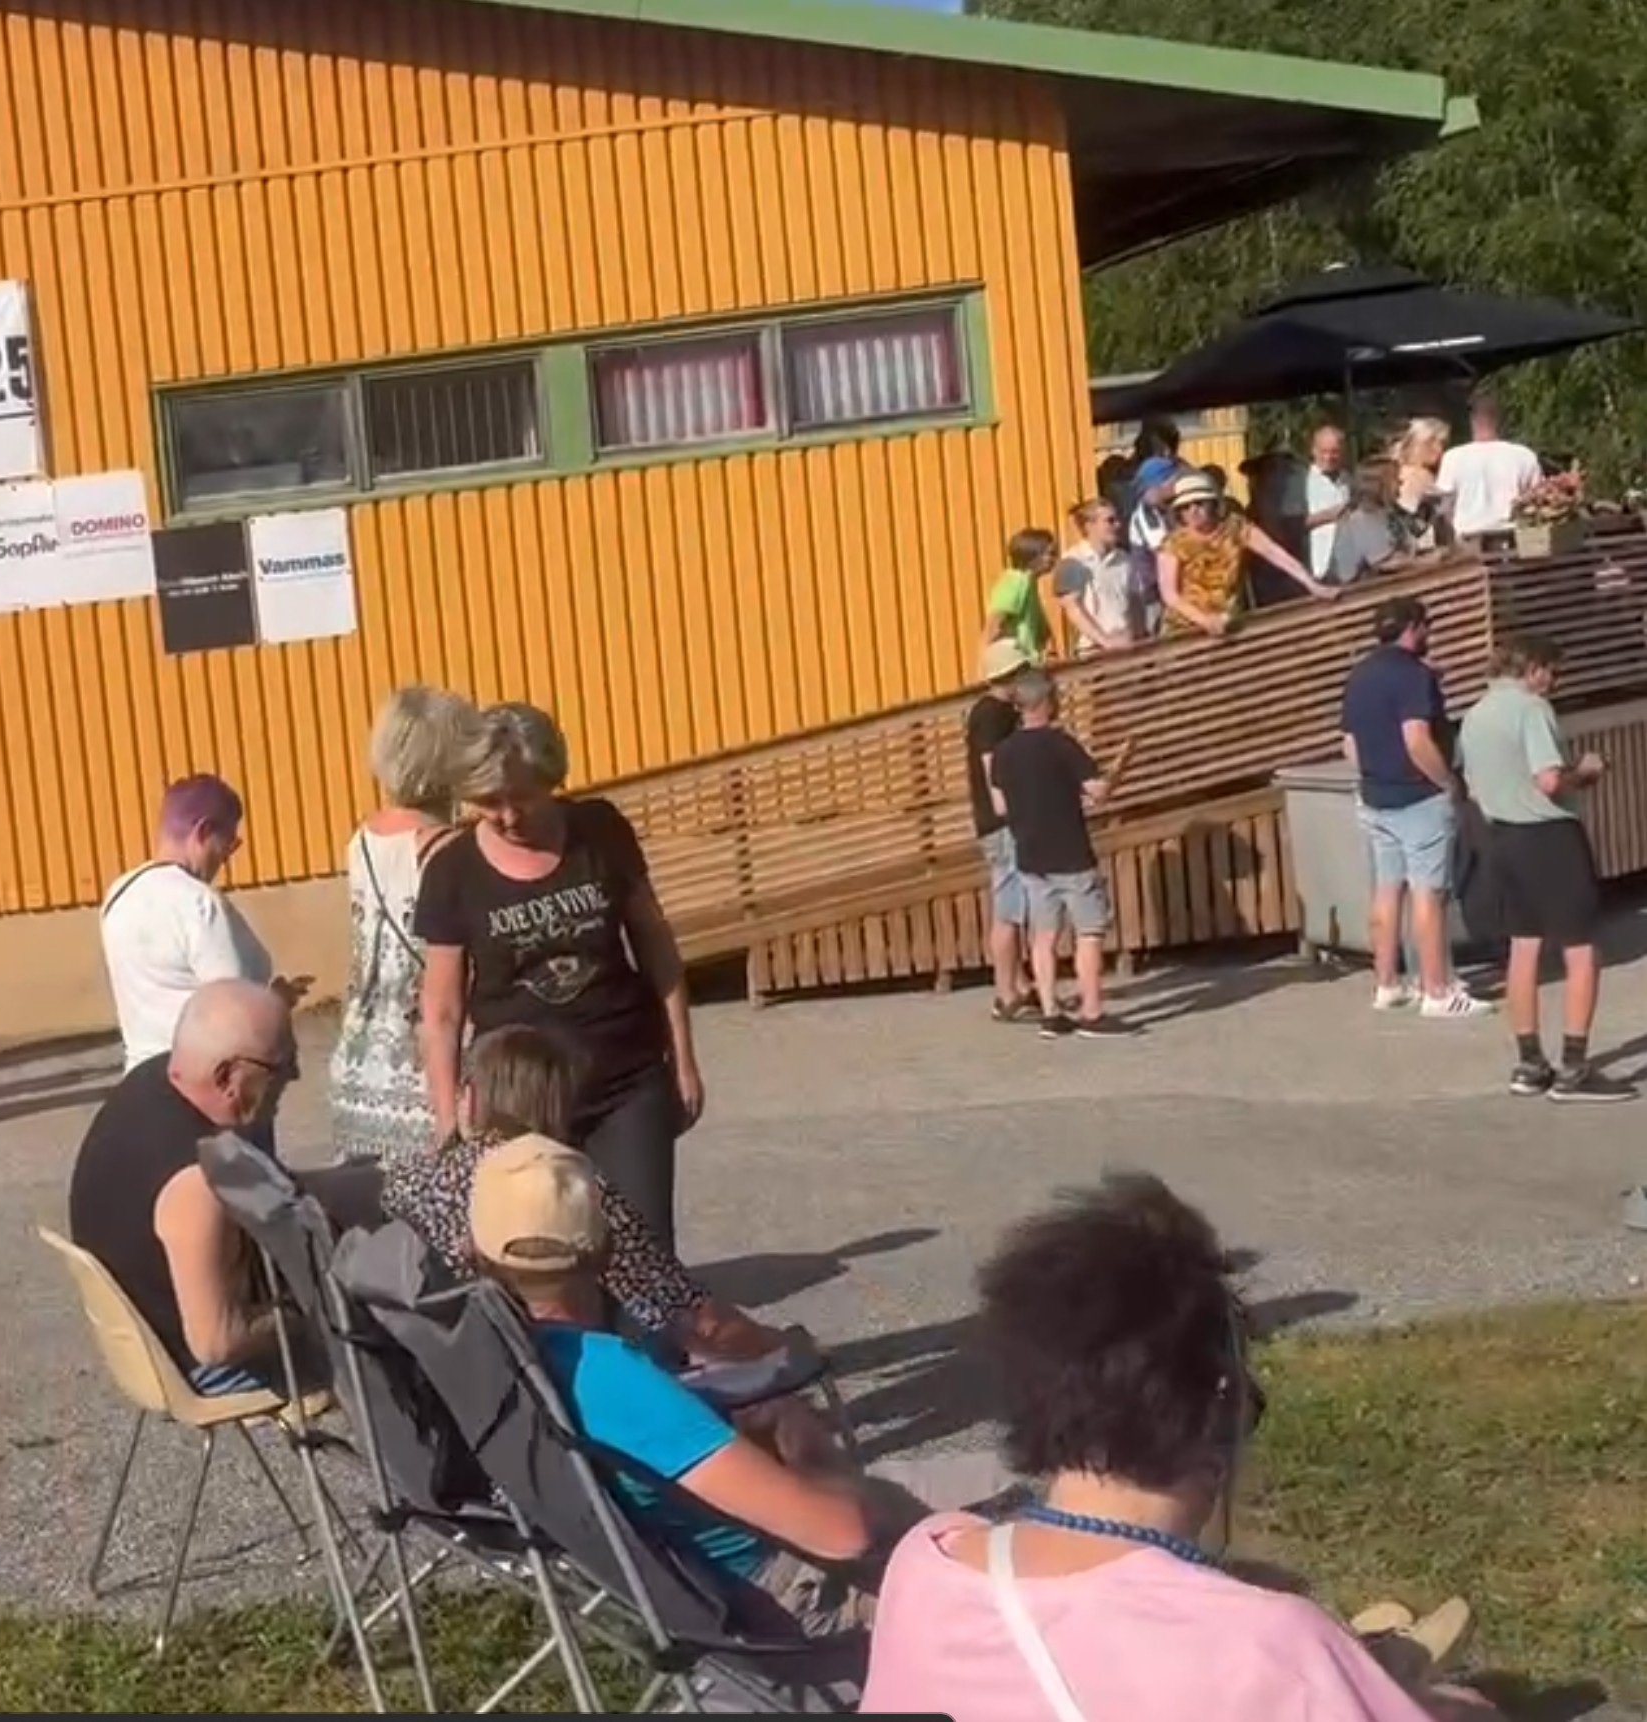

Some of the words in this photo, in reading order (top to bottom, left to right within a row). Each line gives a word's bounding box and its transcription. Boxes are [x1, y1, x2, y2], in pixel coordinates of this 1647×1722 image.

[71, 512, 145, 536] DOMINO
[258, 551, 346, 576] Vammas
[489, 902, 530, 937] JOIE
[527, 894, 558, 926] DE
